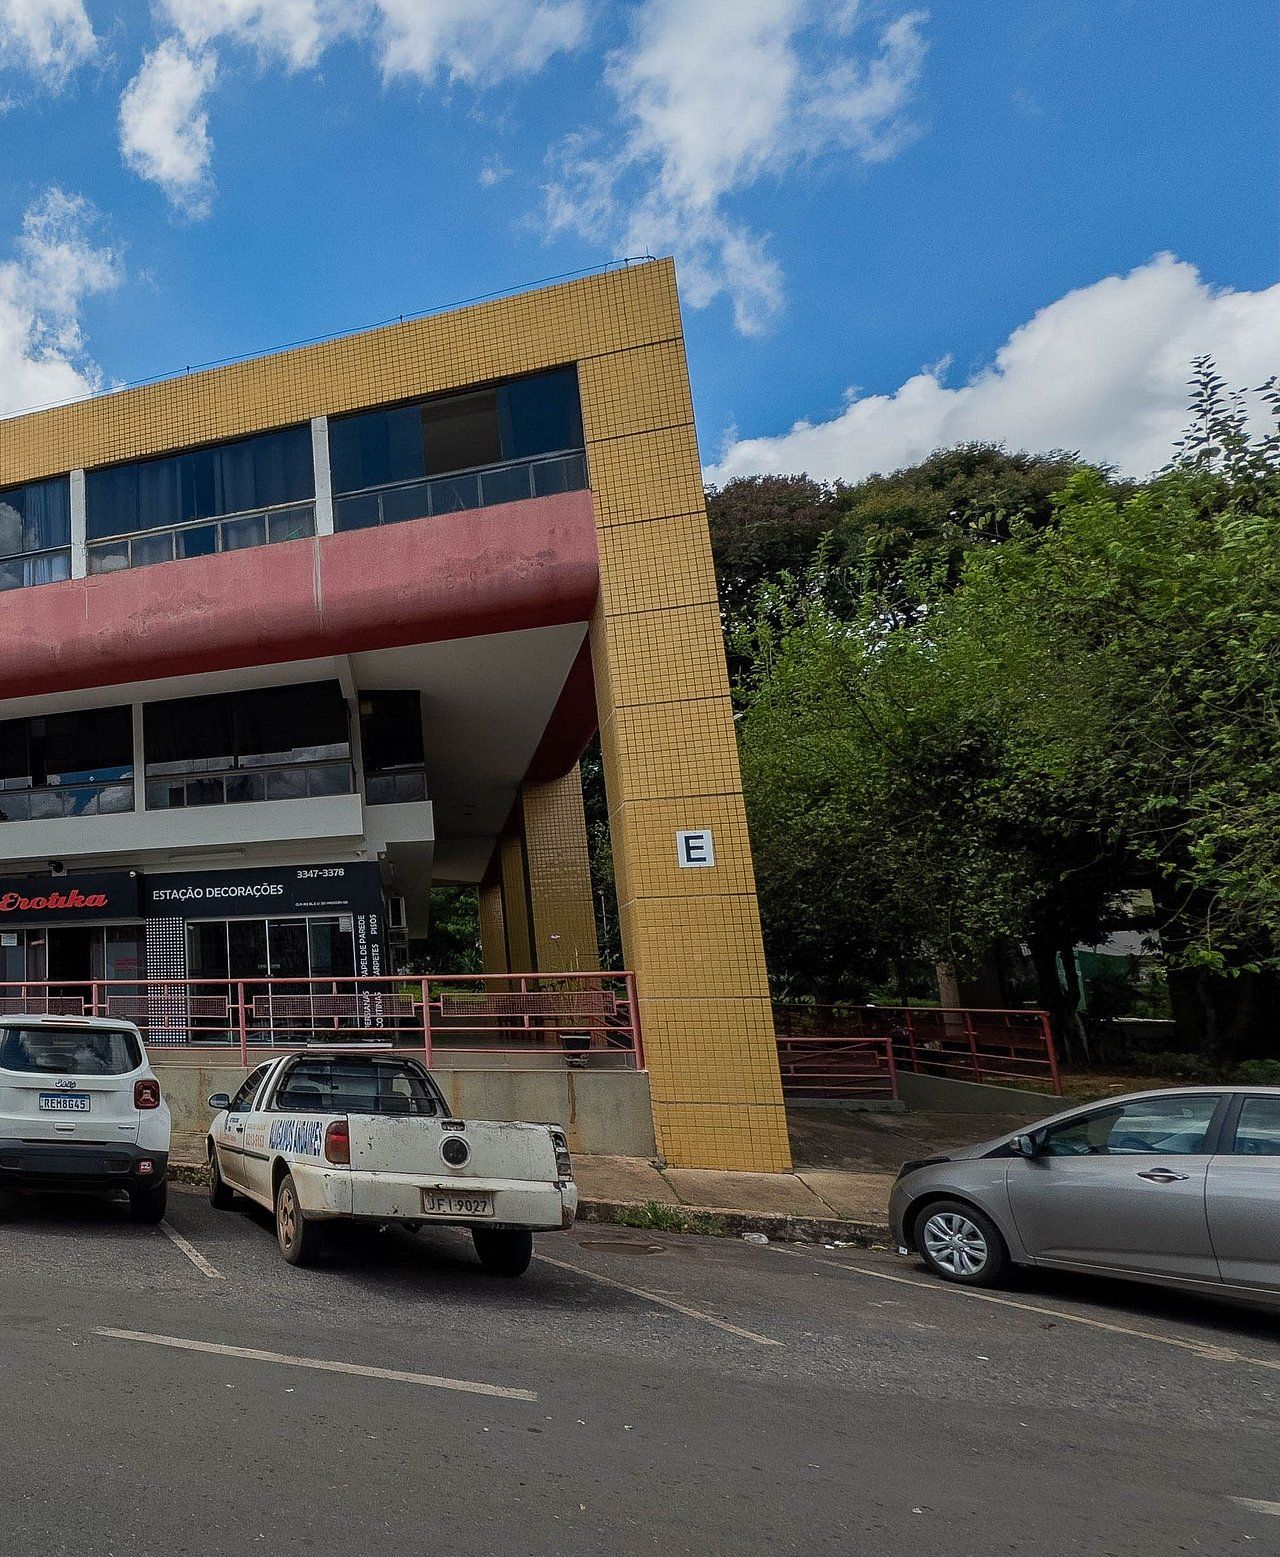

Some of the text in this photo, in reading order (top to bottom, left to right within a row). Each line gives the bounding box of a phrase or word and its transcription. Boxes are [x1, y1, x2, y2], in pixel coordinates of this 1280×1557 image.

[684, 835, 707, 862] E
[297, 868, 345, 879] 3347-3378
[153, 883, 283, 901] ESTAÇÃO DECORAÇÕES
[358, 915, 366, 943] PAREDE
[370, 914, 378, 935] PISOS
[360, 945, 367, 955] DE
[372, 944, 380, 977] ARPETES
